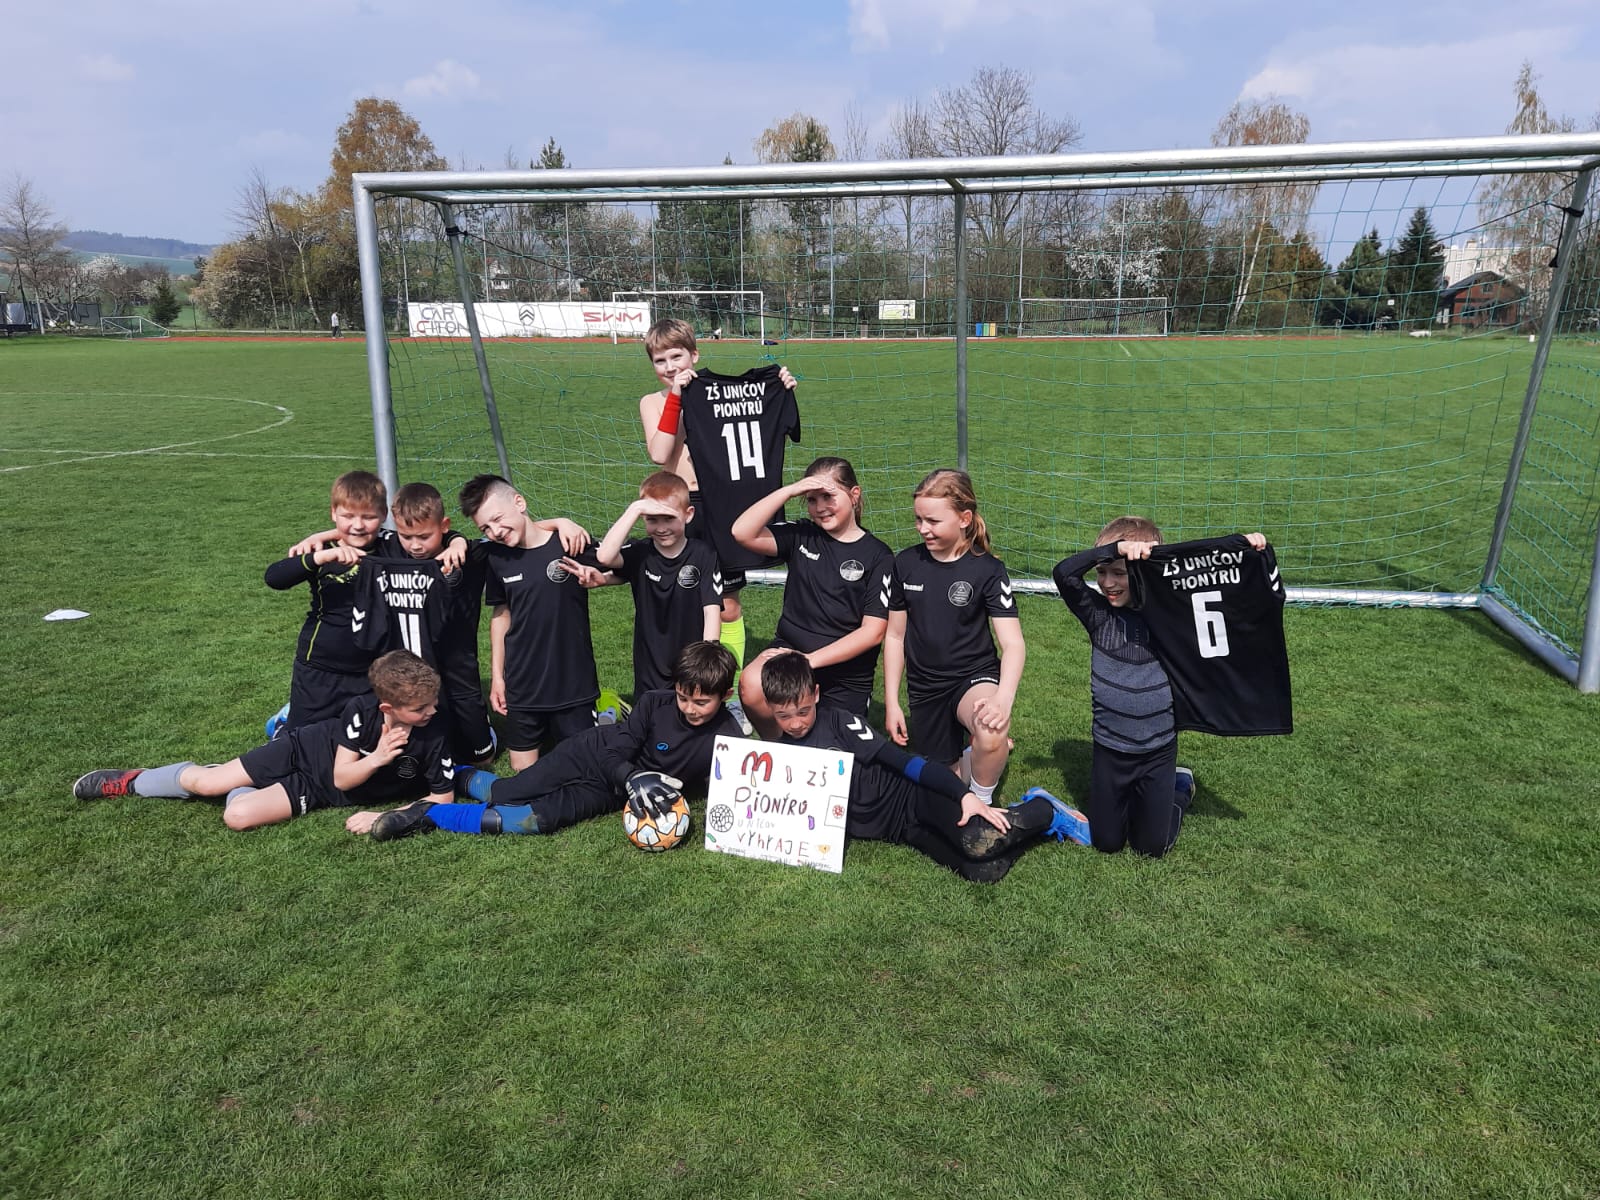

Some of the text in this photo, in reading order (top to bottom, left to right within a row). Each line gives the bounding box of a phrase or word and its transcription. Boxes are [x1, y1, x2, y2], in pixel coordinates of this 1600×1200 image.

[420, 307, 454, 321] CAR
[705, 380, 766, 401] ZŠ UNIČOV
[713, 396, 763, 418] PIONÝRŮ
[721, 420, 766, 481] 14
[1162, 549, 1244, 577] ZŠ UNIČOV
[390, 569, 435, 590] UNIČOV
[1171, 564, 1241, 590] PIONÝRŮ
[1191, 590, 1230, 659] 6
